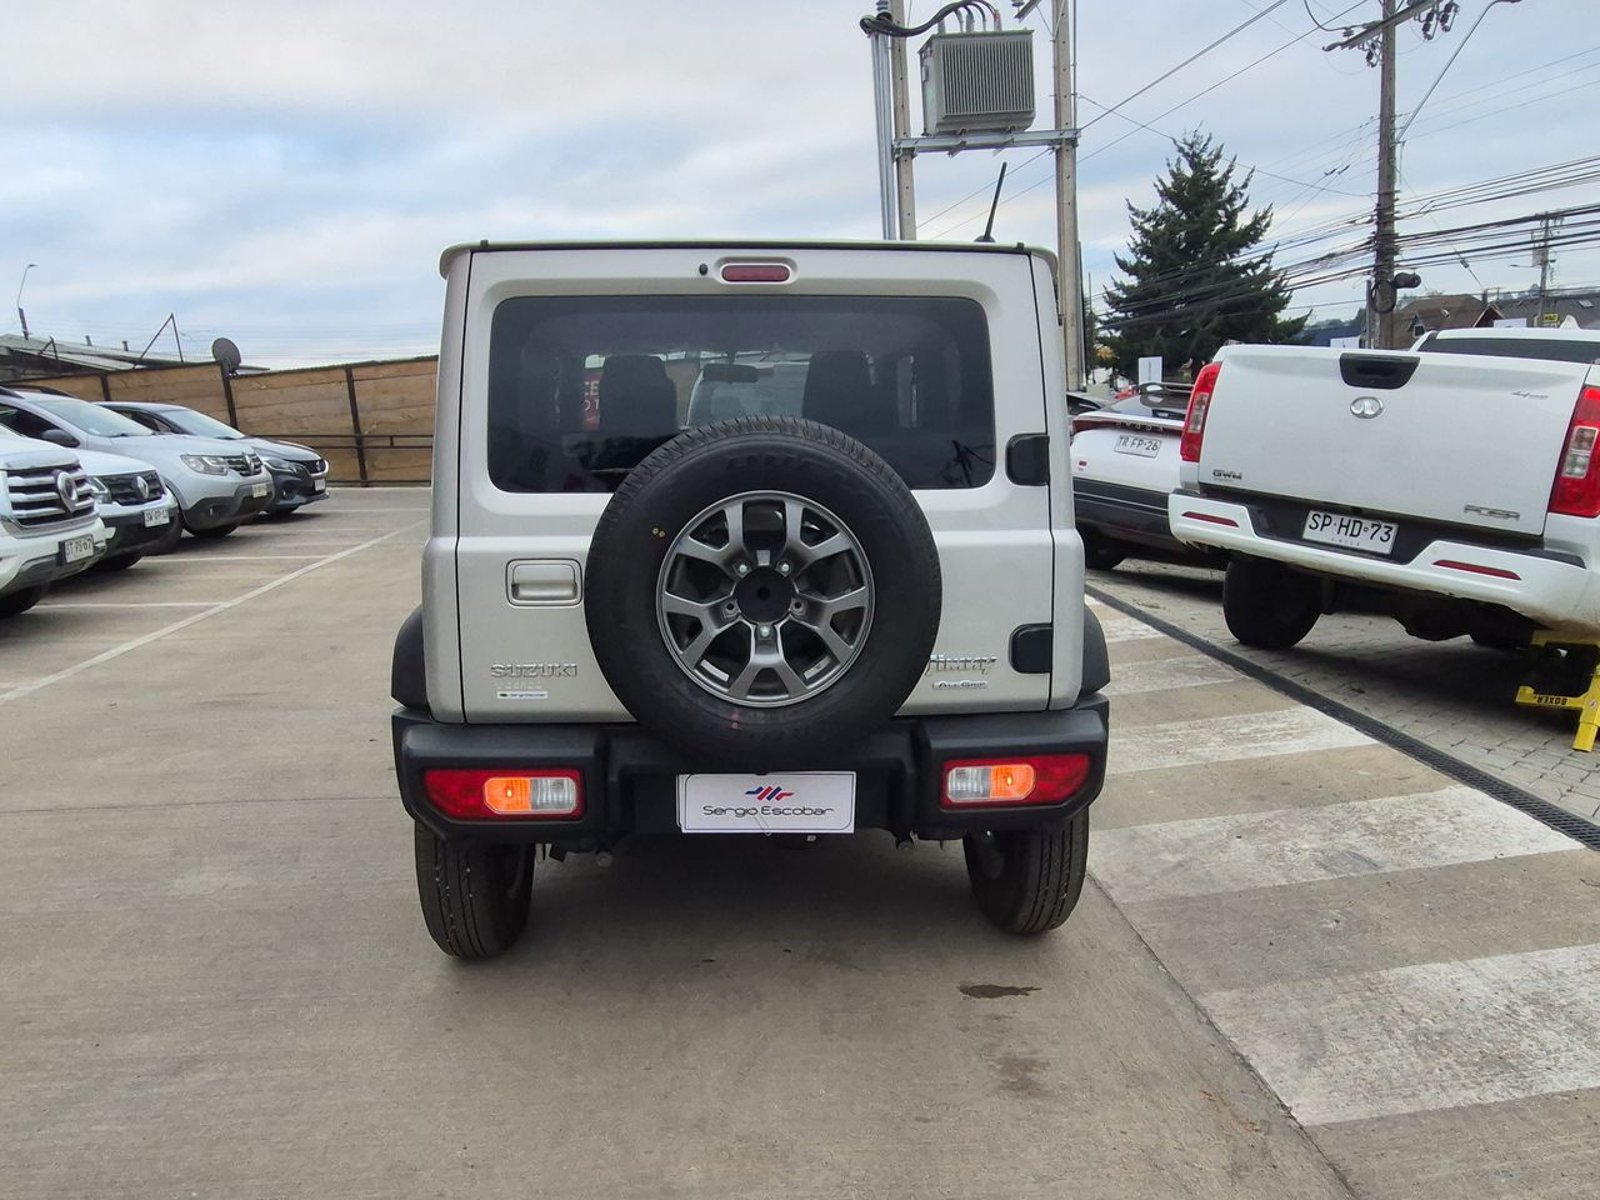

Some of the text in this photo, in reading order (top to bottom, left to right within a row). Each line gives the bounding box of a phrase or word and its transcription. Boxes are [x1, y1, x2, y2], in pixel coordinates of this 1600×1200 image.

[491, 663, 578, 678] SUZUKI
[702, 805, 834, 818] Sergio Escobar
